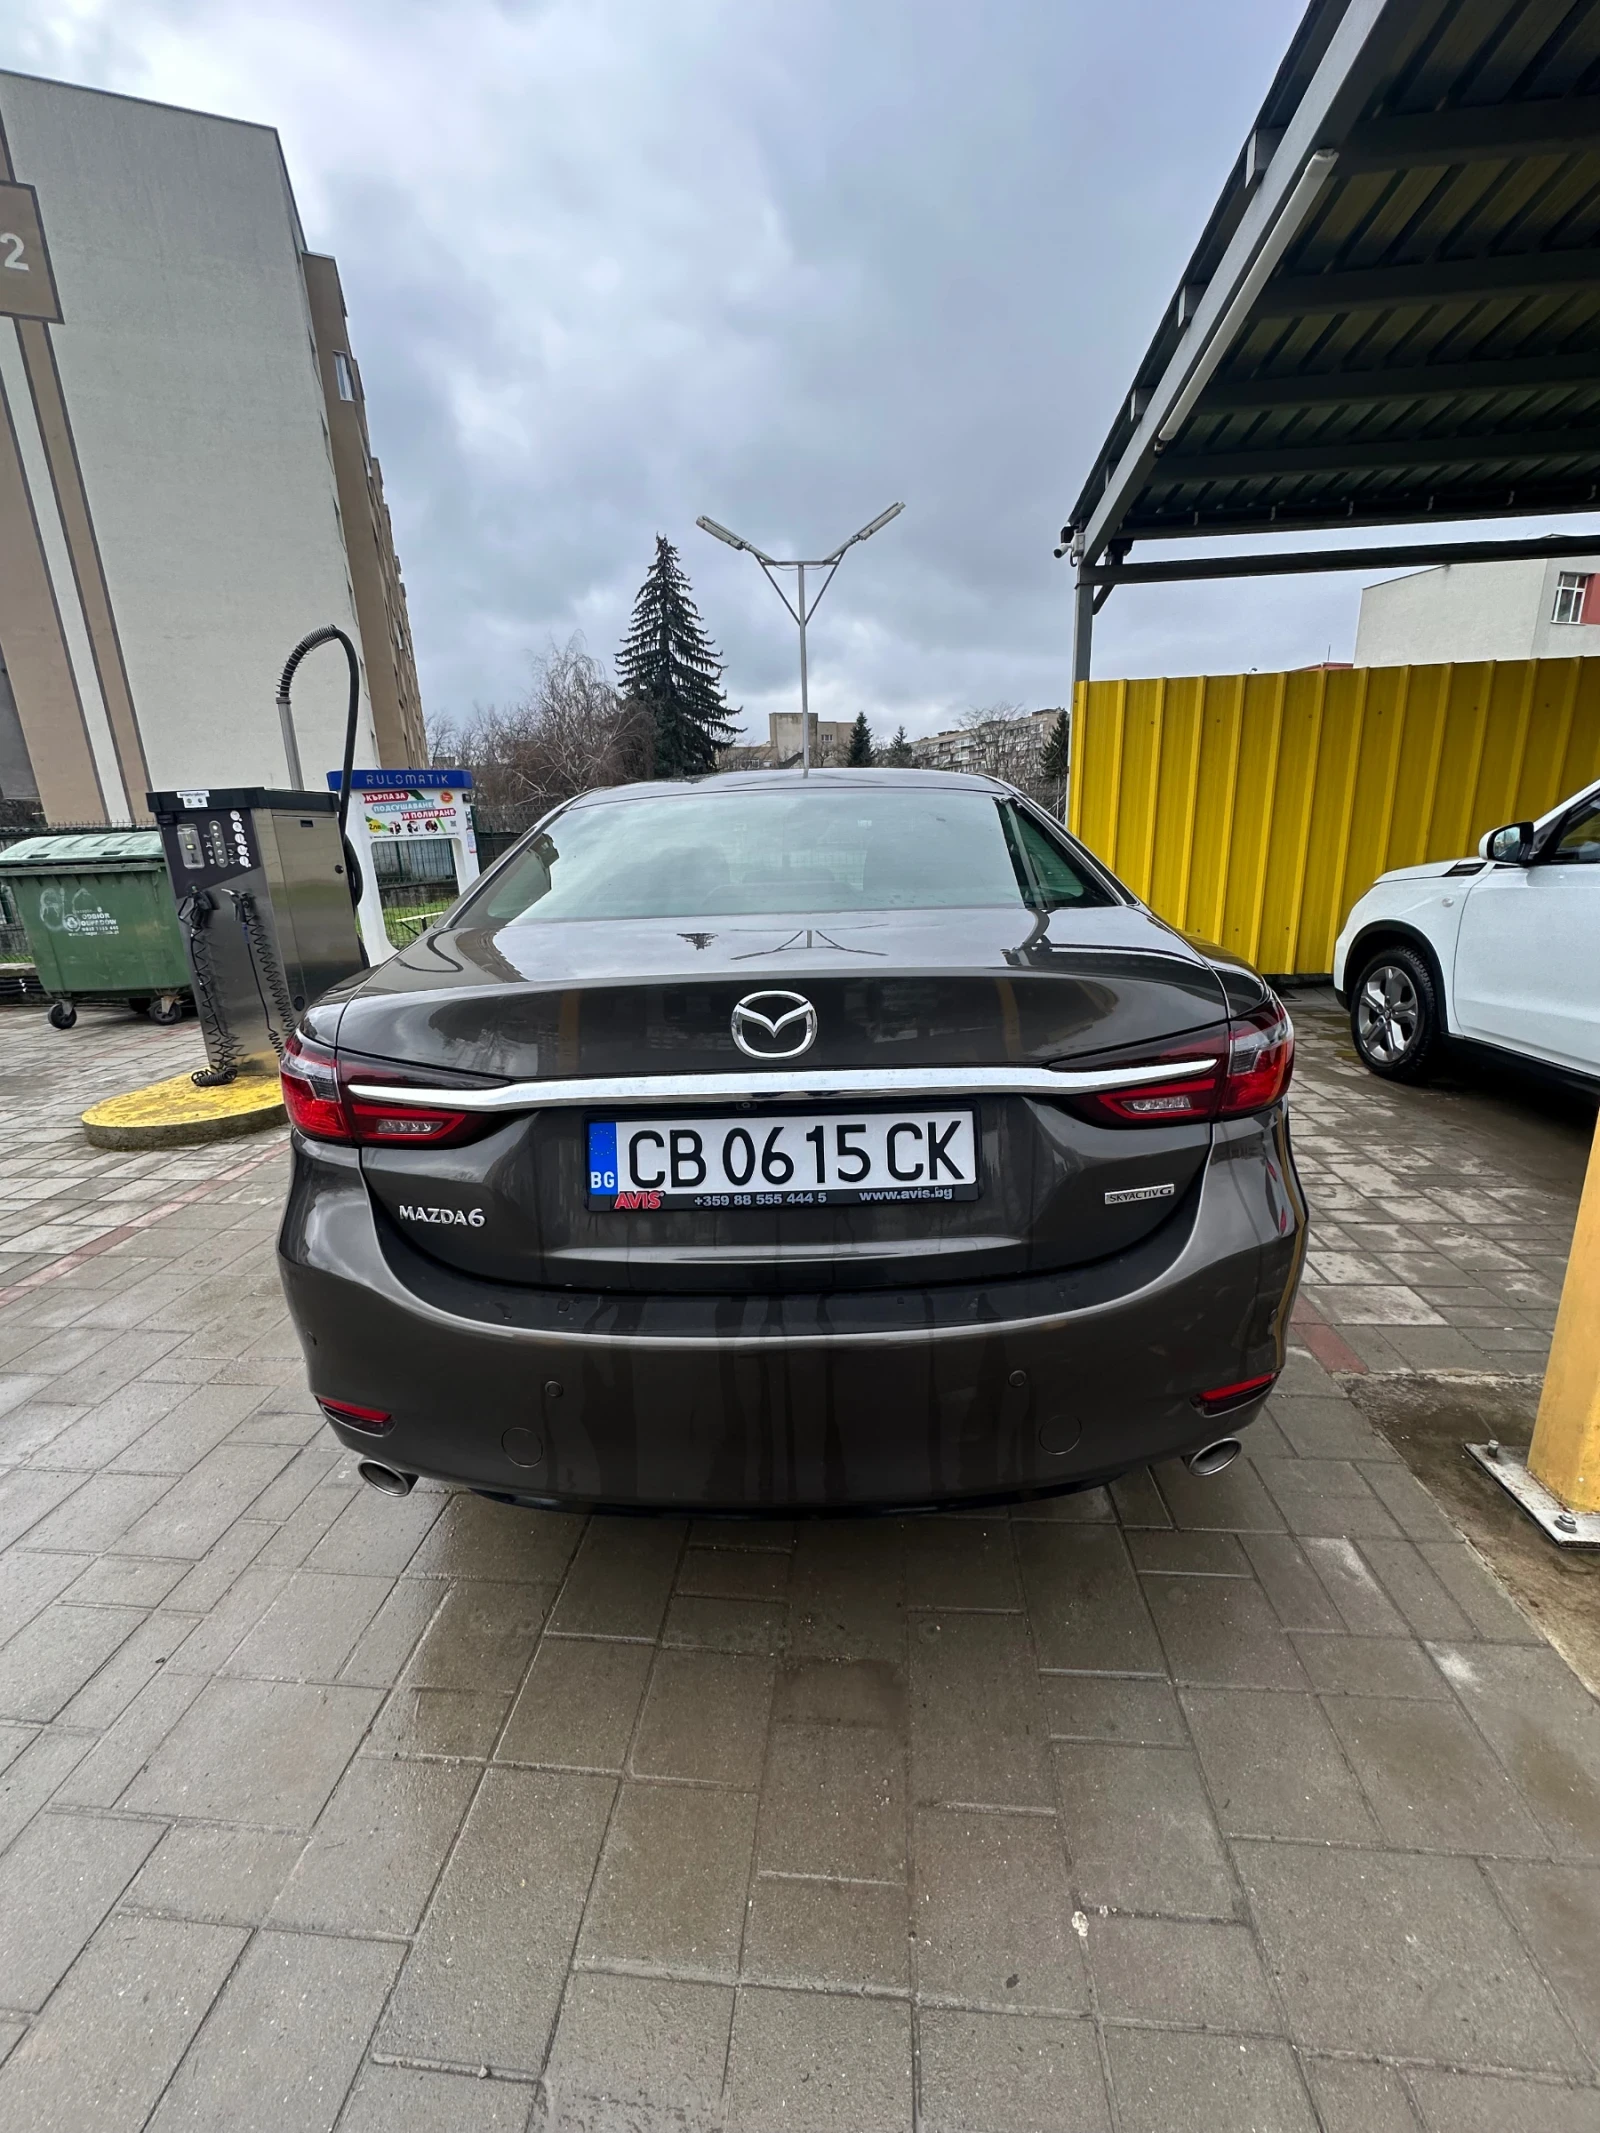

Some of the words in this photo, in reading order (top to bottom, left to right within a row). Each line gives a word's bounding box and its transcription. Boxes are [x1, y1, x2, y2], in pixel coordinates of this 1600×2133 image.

[366, 774, 449, 785] RULOMATIK
[365, 793, 394, 802] КЪРПА
[373, 801, 433, 812] ПОДСУШАВАНЕ
[411, 809, 455, 819] ПОЛИРАНЕ
[629, 1129, 706, 1189] CB
[722, 1123, 871, 1186] 0615
[886, 1120, 965, 1181] CK
[591, 1171, 615, 1189] BG
[694, 1195, 729, 1207] +359
[733, 1195, 752, 1206] 88
[756, 1194, 783, 1205] 555
[786, 1193, 813, 1205] 444
[817, 1192, 827, 1203] 5
[859, 1187, 953, 1201] www.avis.bg
